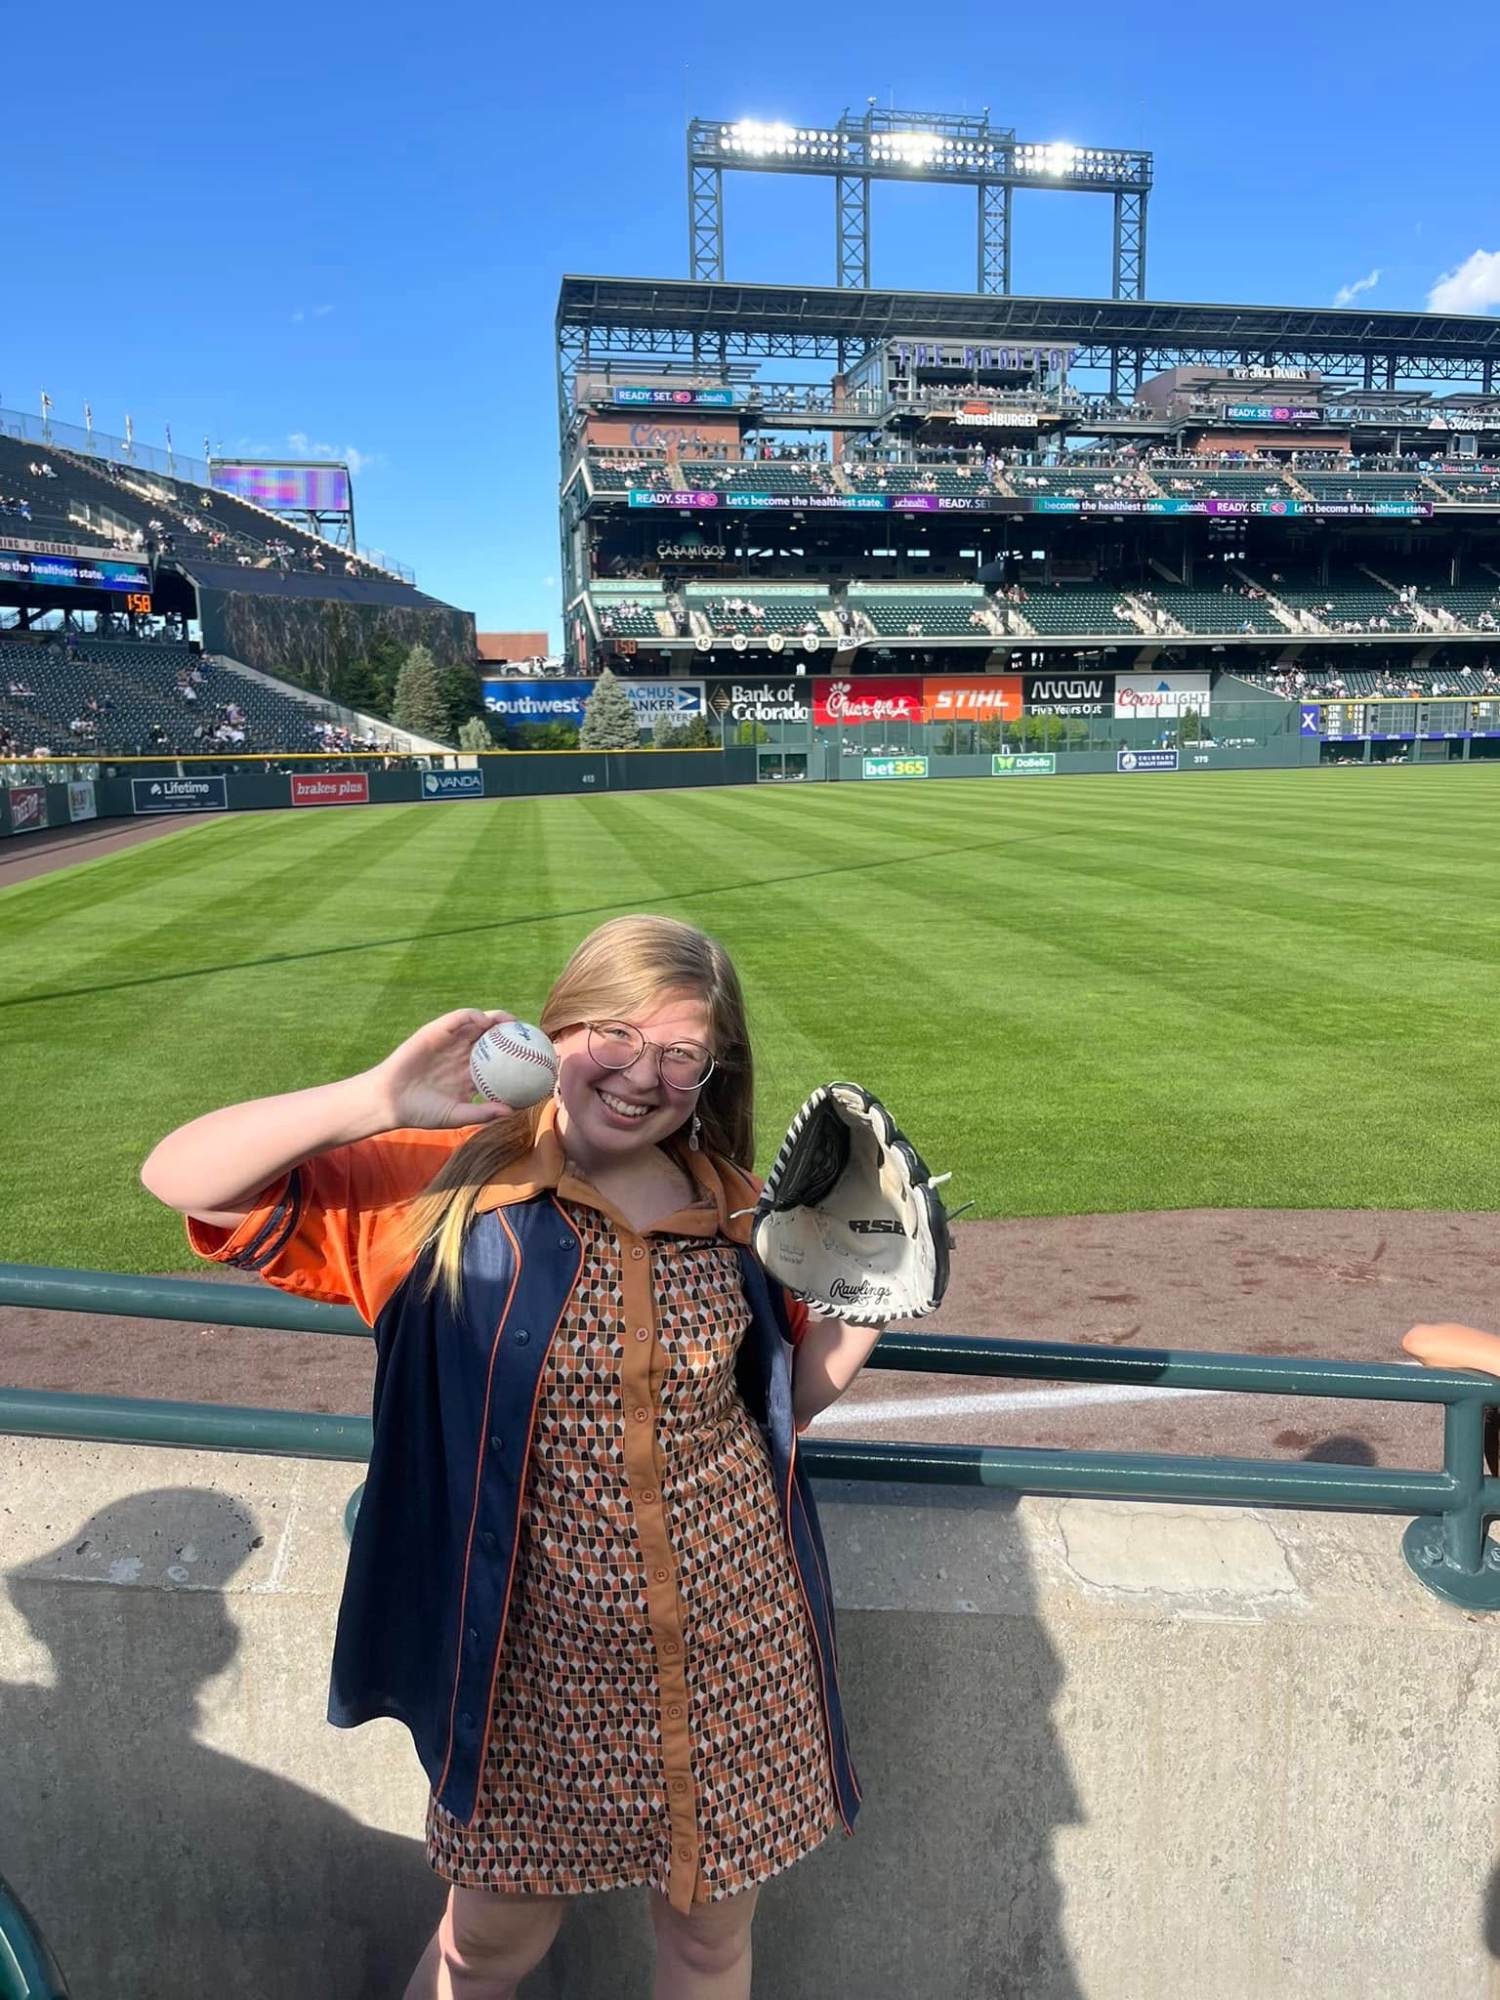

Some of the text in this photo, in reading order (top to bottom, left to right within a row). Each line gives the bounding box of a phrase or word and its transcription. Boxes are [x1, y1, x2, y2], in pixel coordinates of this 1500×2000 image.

[897, 343, 1077, 371] THE ROOFTOP
[619, 391, 672, 401] READY. SET.
[1228, 408, 1273, 418] READY. SET.
[635, 493, 696, 504] READY. SET.
[726, 494, 883, 508] Let's become the healthiest state.
[938, 498, 973, 508] READY.
[1044, 500, 1166, 512] become the healthiest state.
[1216, 502, 1269, 513] READY. SET.
[1294, 503, 1428, 514] Let's become the healthiest state.
[34, 541, 79, 557] COLORADO
[656, 545, 727, 556] CASAMIGOS
[12, 560, 30, 573] the
[31, 561, 78, 577] healthiest
[79, 568, 105, 580] state.
[697, 638, 708, 649] 42
[770, 638, 780, 649] 17
[806, 638, 817, 649] 33
[628, 687, 675, 699] ACHUS
[732, 683, 796, 703] Bank of
[1031, 680, 1103, 699] ARROW
[935, 690, 1010, 708] STIHL
[1117, 687, 1207, 706] Coors LIGHT
[484, 696, 579, 714] Southwest
[632, 700, 675, 711] ANKER
[732, 701, 809, 721] Colorado
[1031, 704, 1052, 715] Five
[1053, 704, 1081, 715] Years
[1301, 712, 1317, 731] X
[865, 761, 925, 776] bet365
[163, 781, 209, 794] Lifetime
[438, 775, 481, 788] VANDA
[297, 781, 362, 797] brakes plus
[830, 1278, 892, 1305] Rawlings
